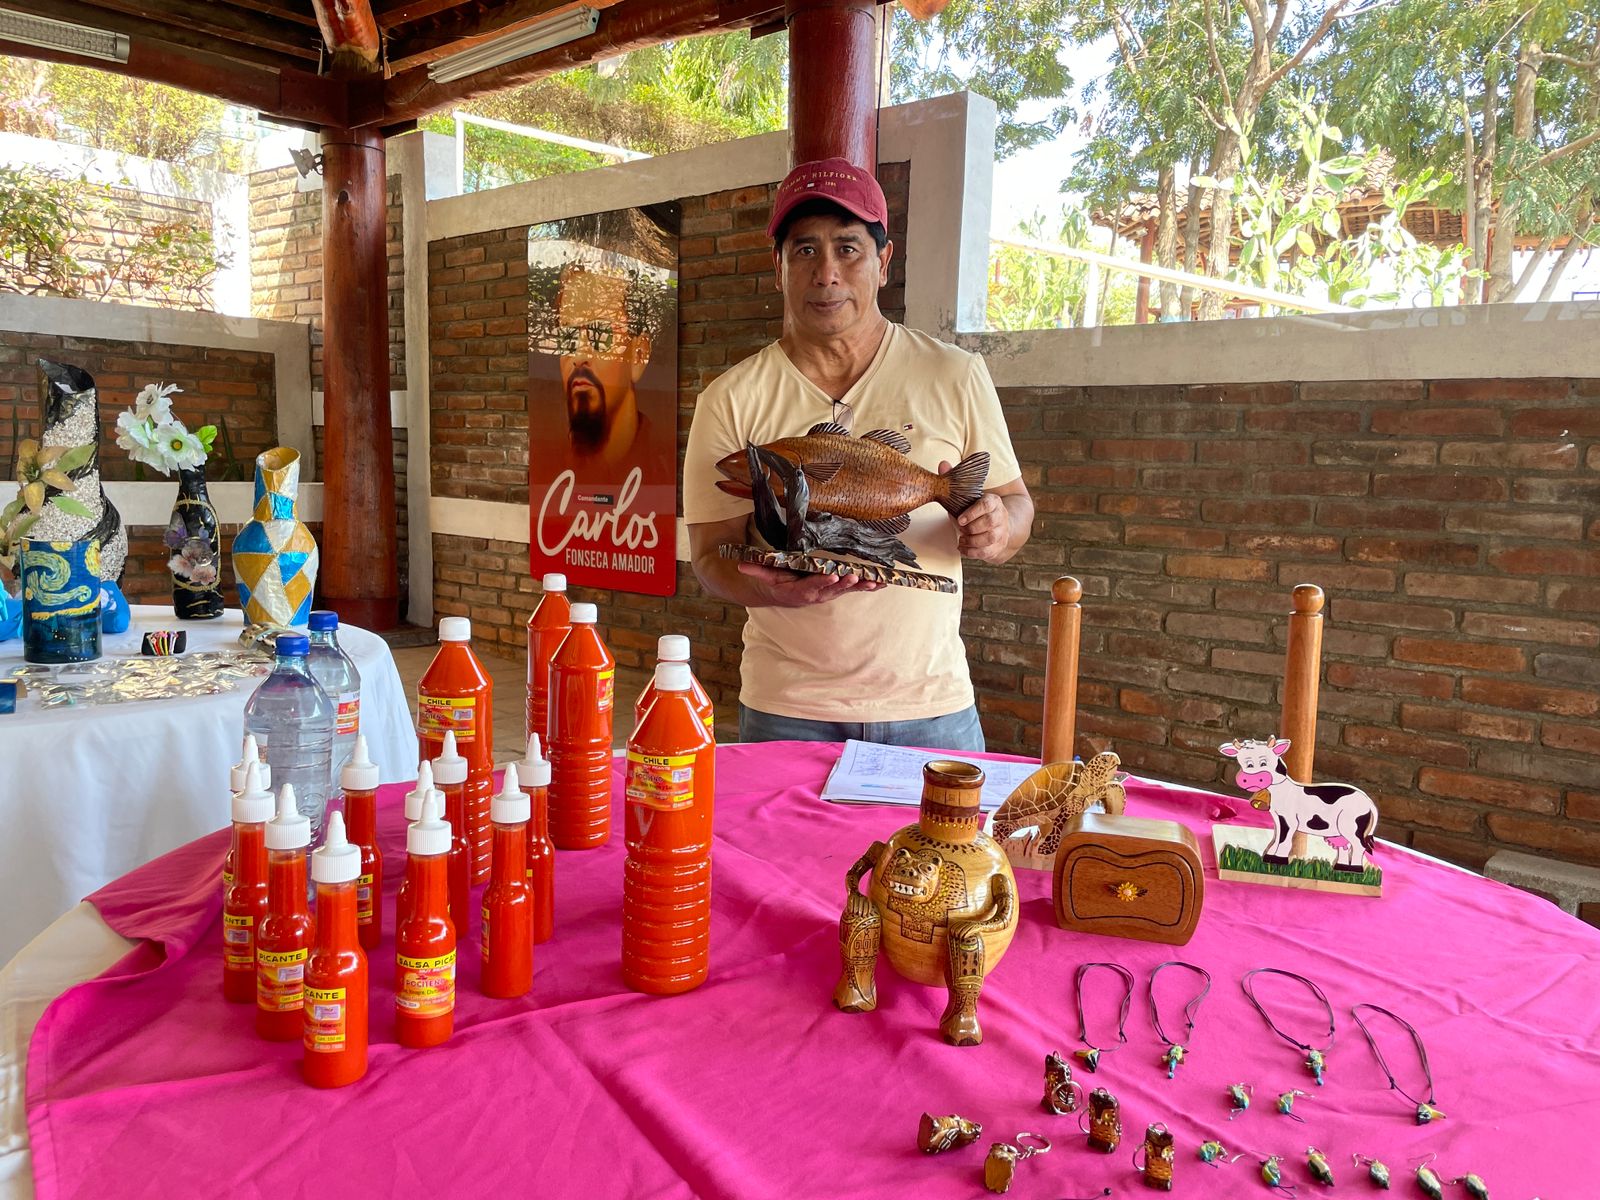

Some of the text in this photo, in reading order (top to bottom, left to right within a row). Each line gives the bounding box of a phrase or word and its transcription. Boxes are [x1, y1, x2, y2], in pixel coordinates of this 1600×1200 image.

[577, 494, 609, 503] Comandante
[537, 466, 659, 557] Carlos
[565, 548, 655, 575] FONSECA AMADOR
[427, 698, 451, 706] CHILE
[643, 756, 669, 766] CHILE
[259, 952, 303, 962] PICANTE
[399, 957, 429, 968] SALSA
